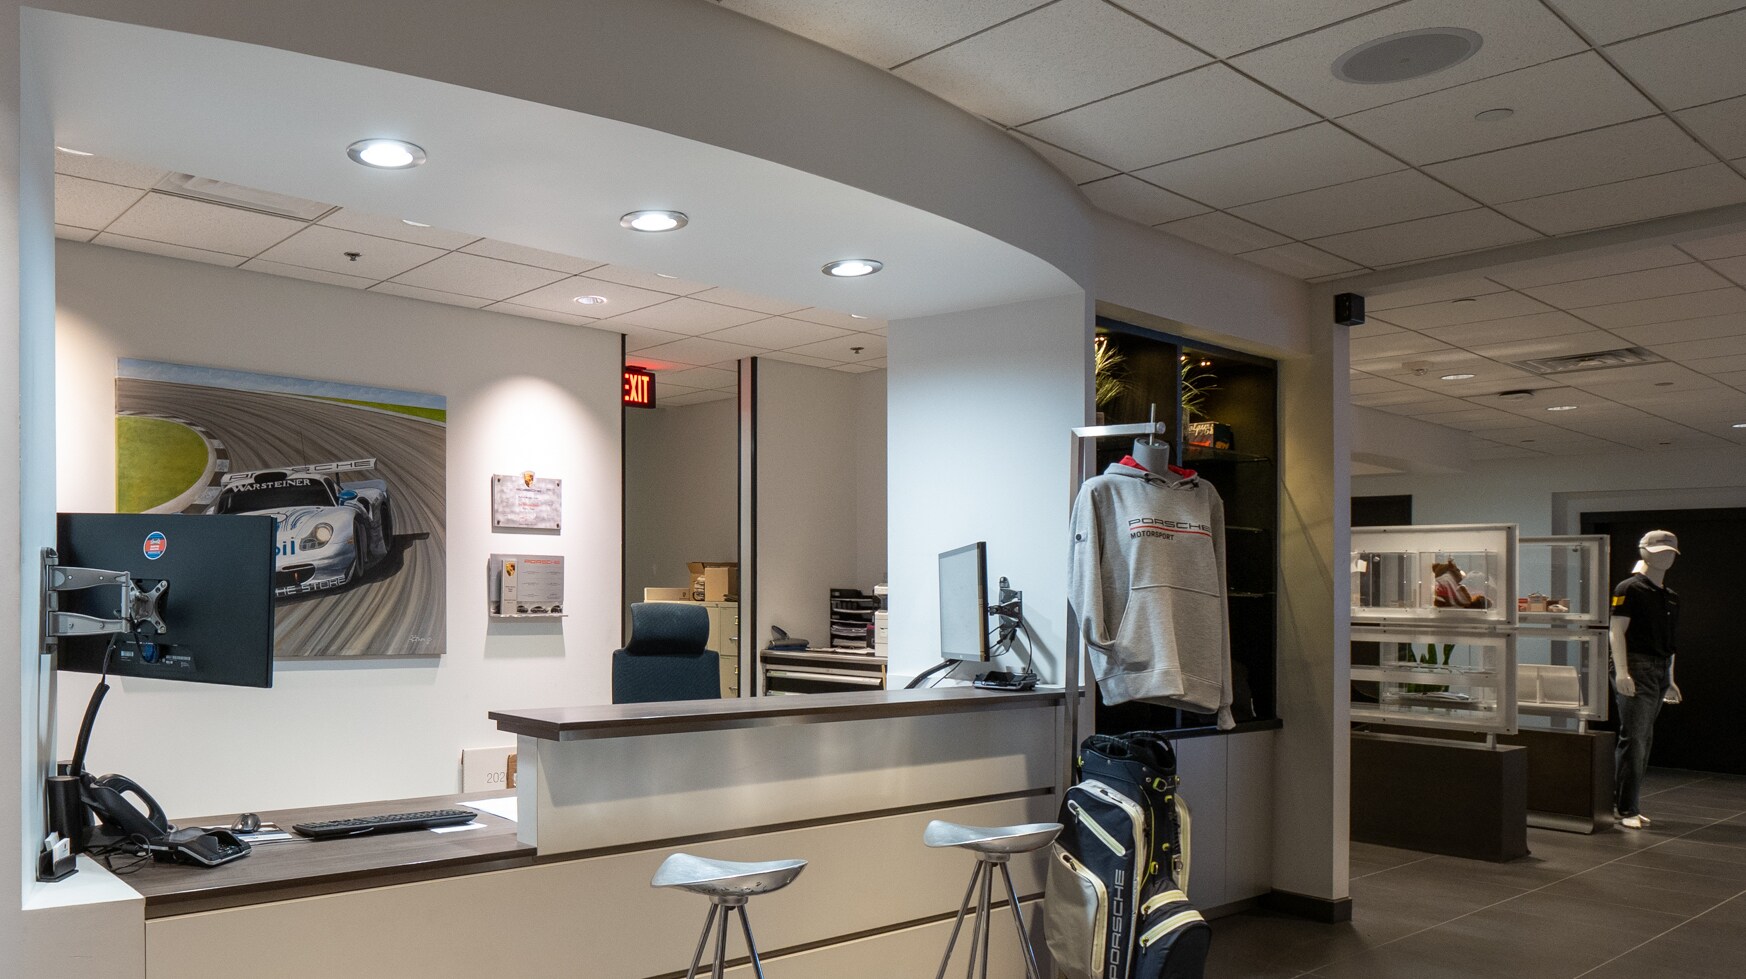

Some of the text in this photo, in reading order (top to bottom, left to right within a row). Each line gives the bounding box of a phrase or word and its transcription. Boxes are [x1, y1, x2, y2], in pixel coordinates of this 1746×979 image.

[231, 478, 311, 493] WARSTEINER
[1128, 517, 1211, 532] PORSCHE
[1130, 530, 1175, 541] MOTORSPORT
[301, 574, 347, 593] STORE
[1108, 869, 1125, 979] PORSCHE
